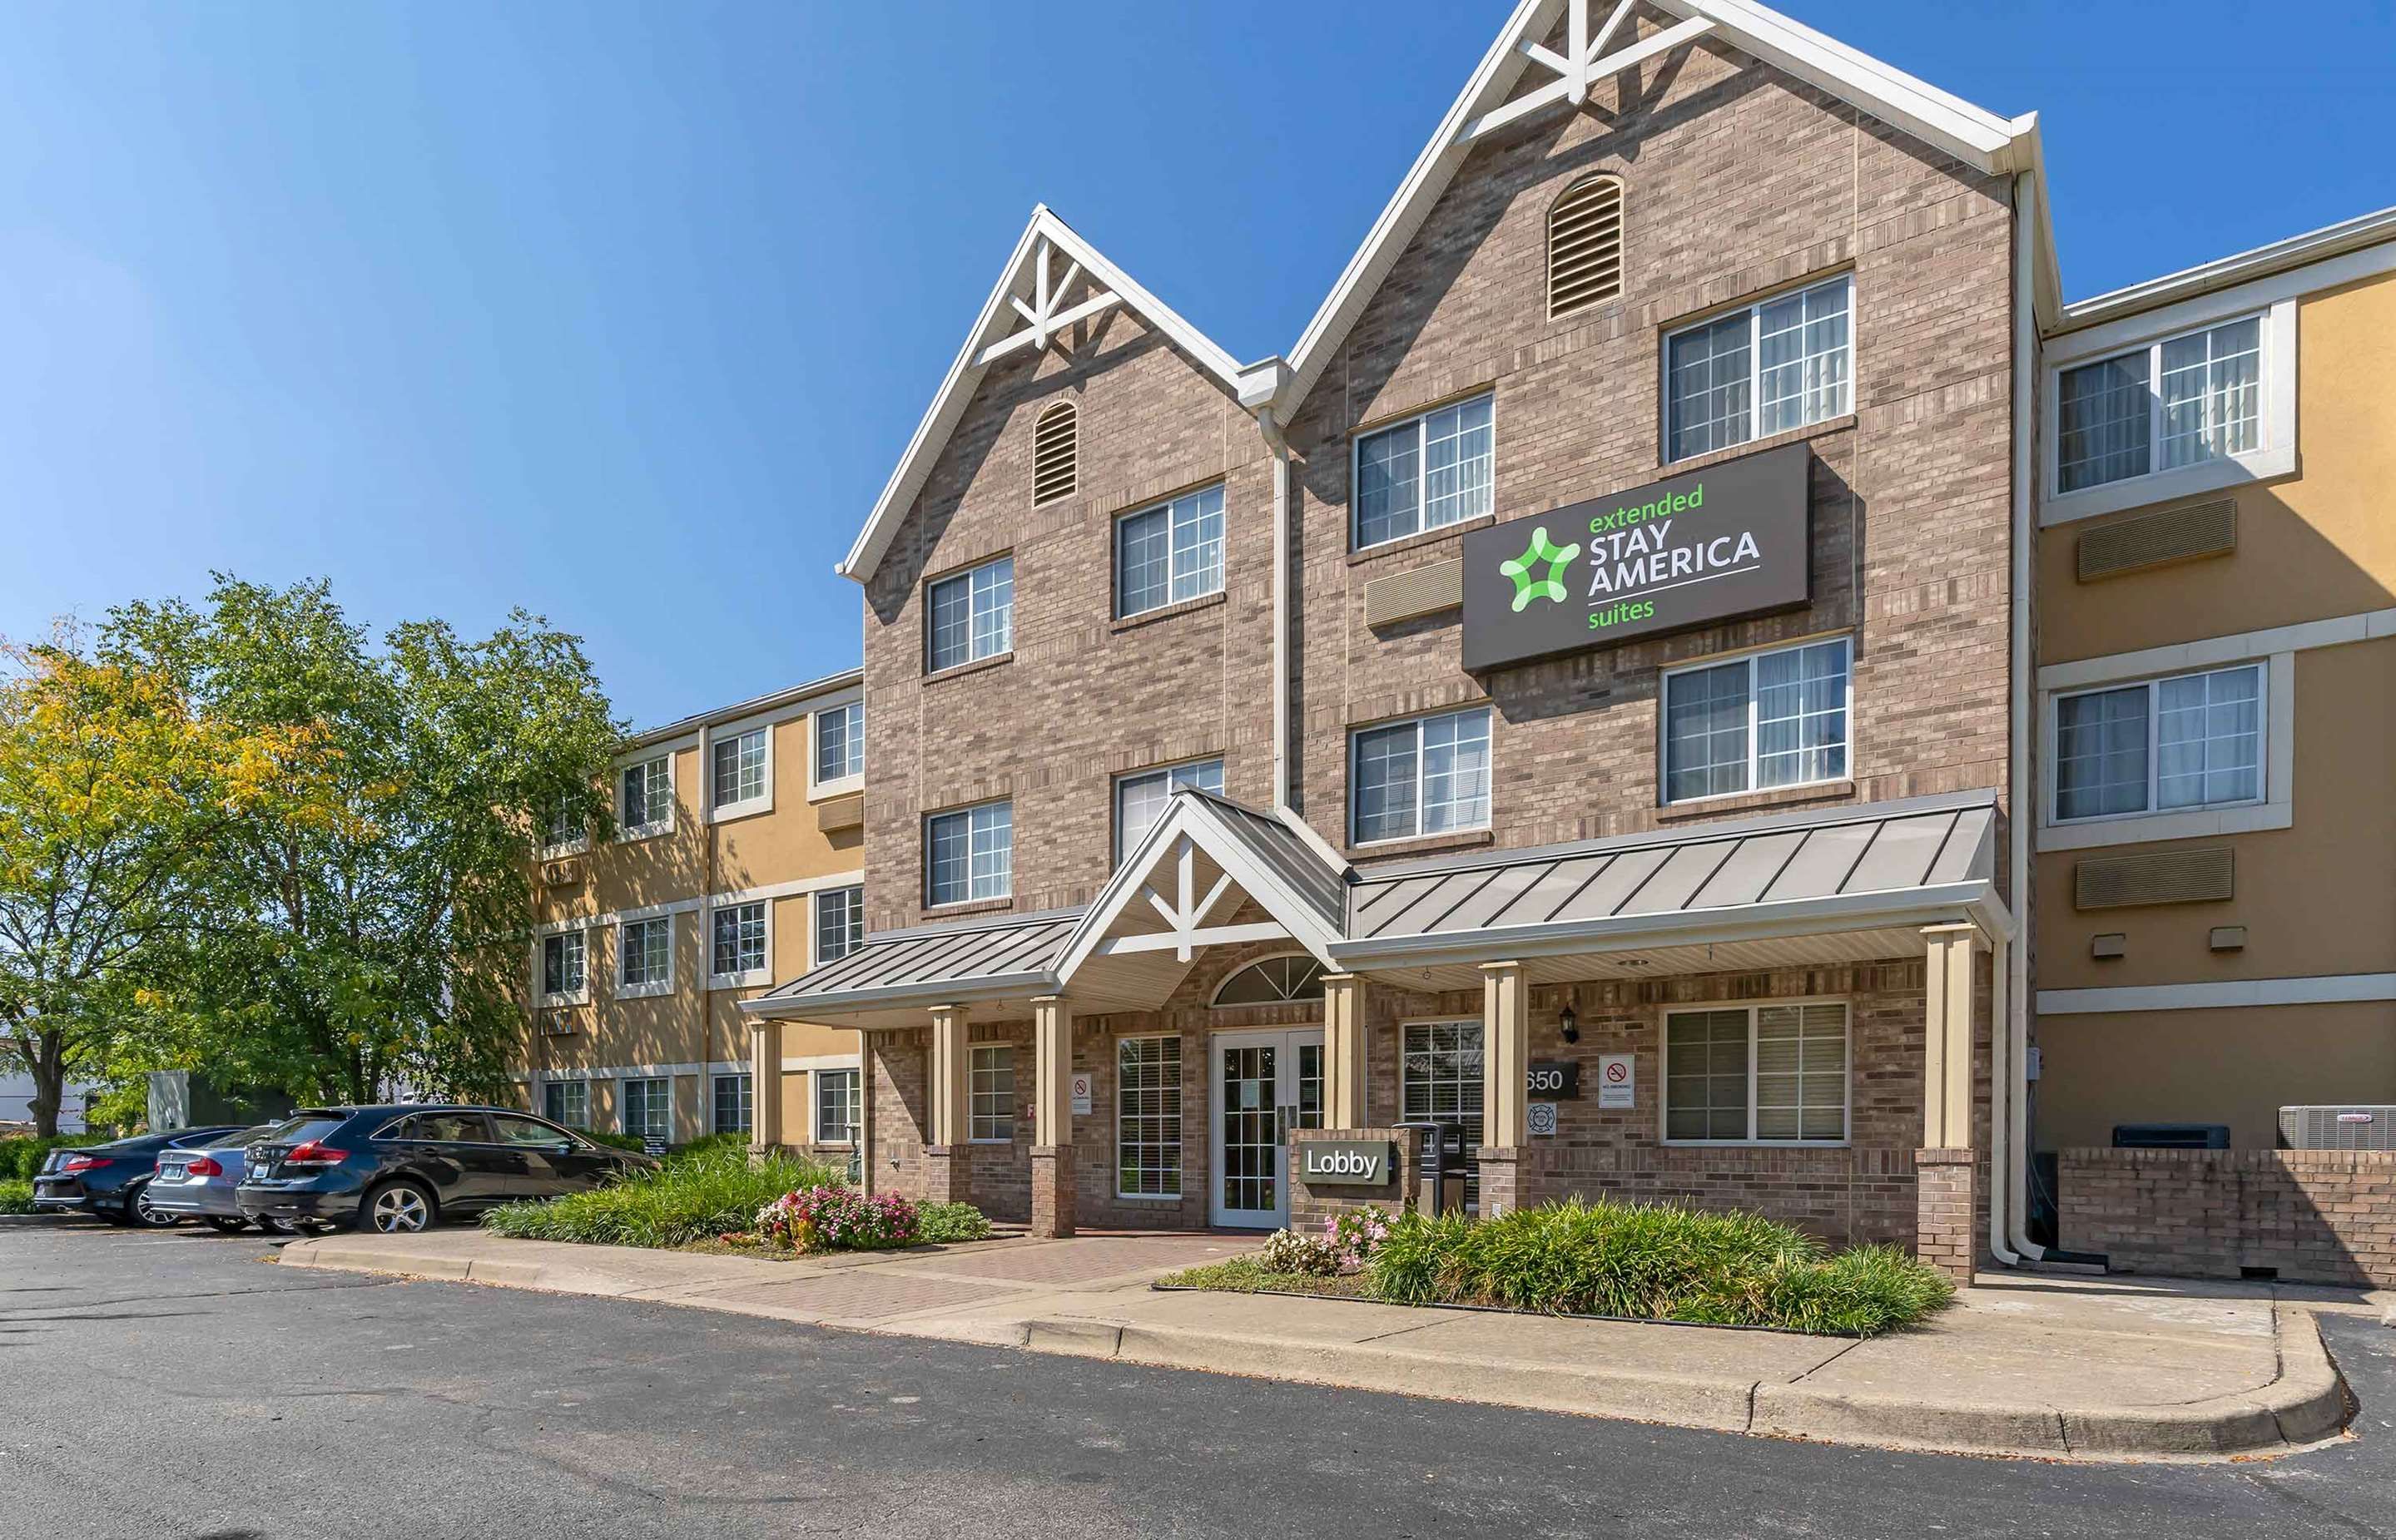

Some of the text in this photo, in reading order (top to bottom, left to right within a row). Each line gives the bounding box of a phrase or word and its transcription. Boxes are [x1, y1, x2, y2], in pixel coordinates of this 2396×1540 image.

[1590, 483, 1704, 534] extended
[1589, 531, 1761, 597] AMERICA
[1590, 520, 1673, 567] STAY
[1588, 601, 1654, 630] suites
[1307, 1150, 1378, 1179] Lobby
